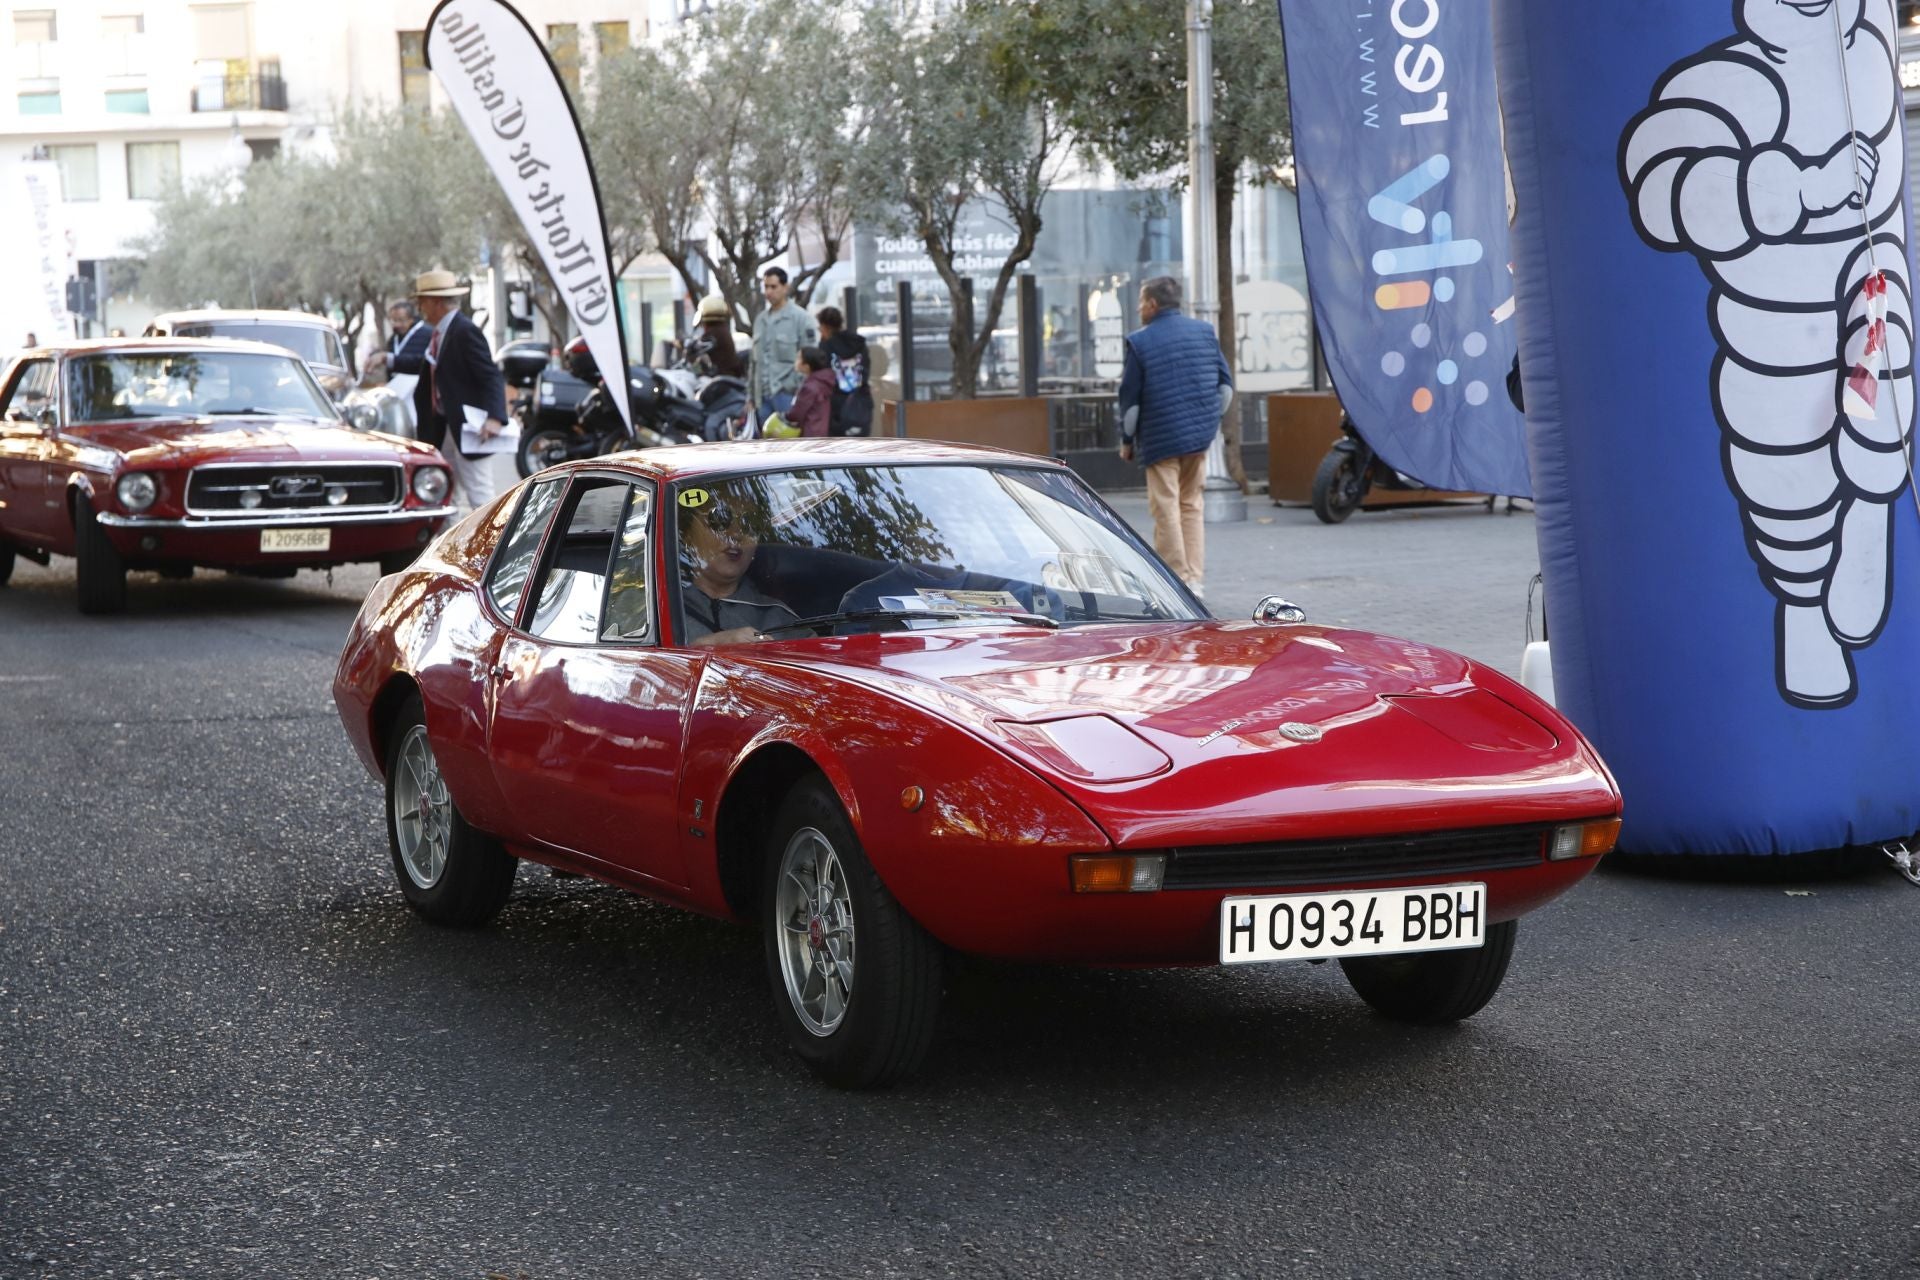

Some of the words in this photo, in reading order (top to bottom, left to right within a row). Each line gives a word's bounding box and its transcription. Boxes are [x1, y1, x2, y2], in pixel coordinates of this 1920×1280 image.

[684, 490, 702, 505] H
[989, 597, 1007, 606] 31
[1229, 904, 1256, 954] H
[1268, 896, 1384, 951] 0934
[1402, 889, 1480, 943] BBH
